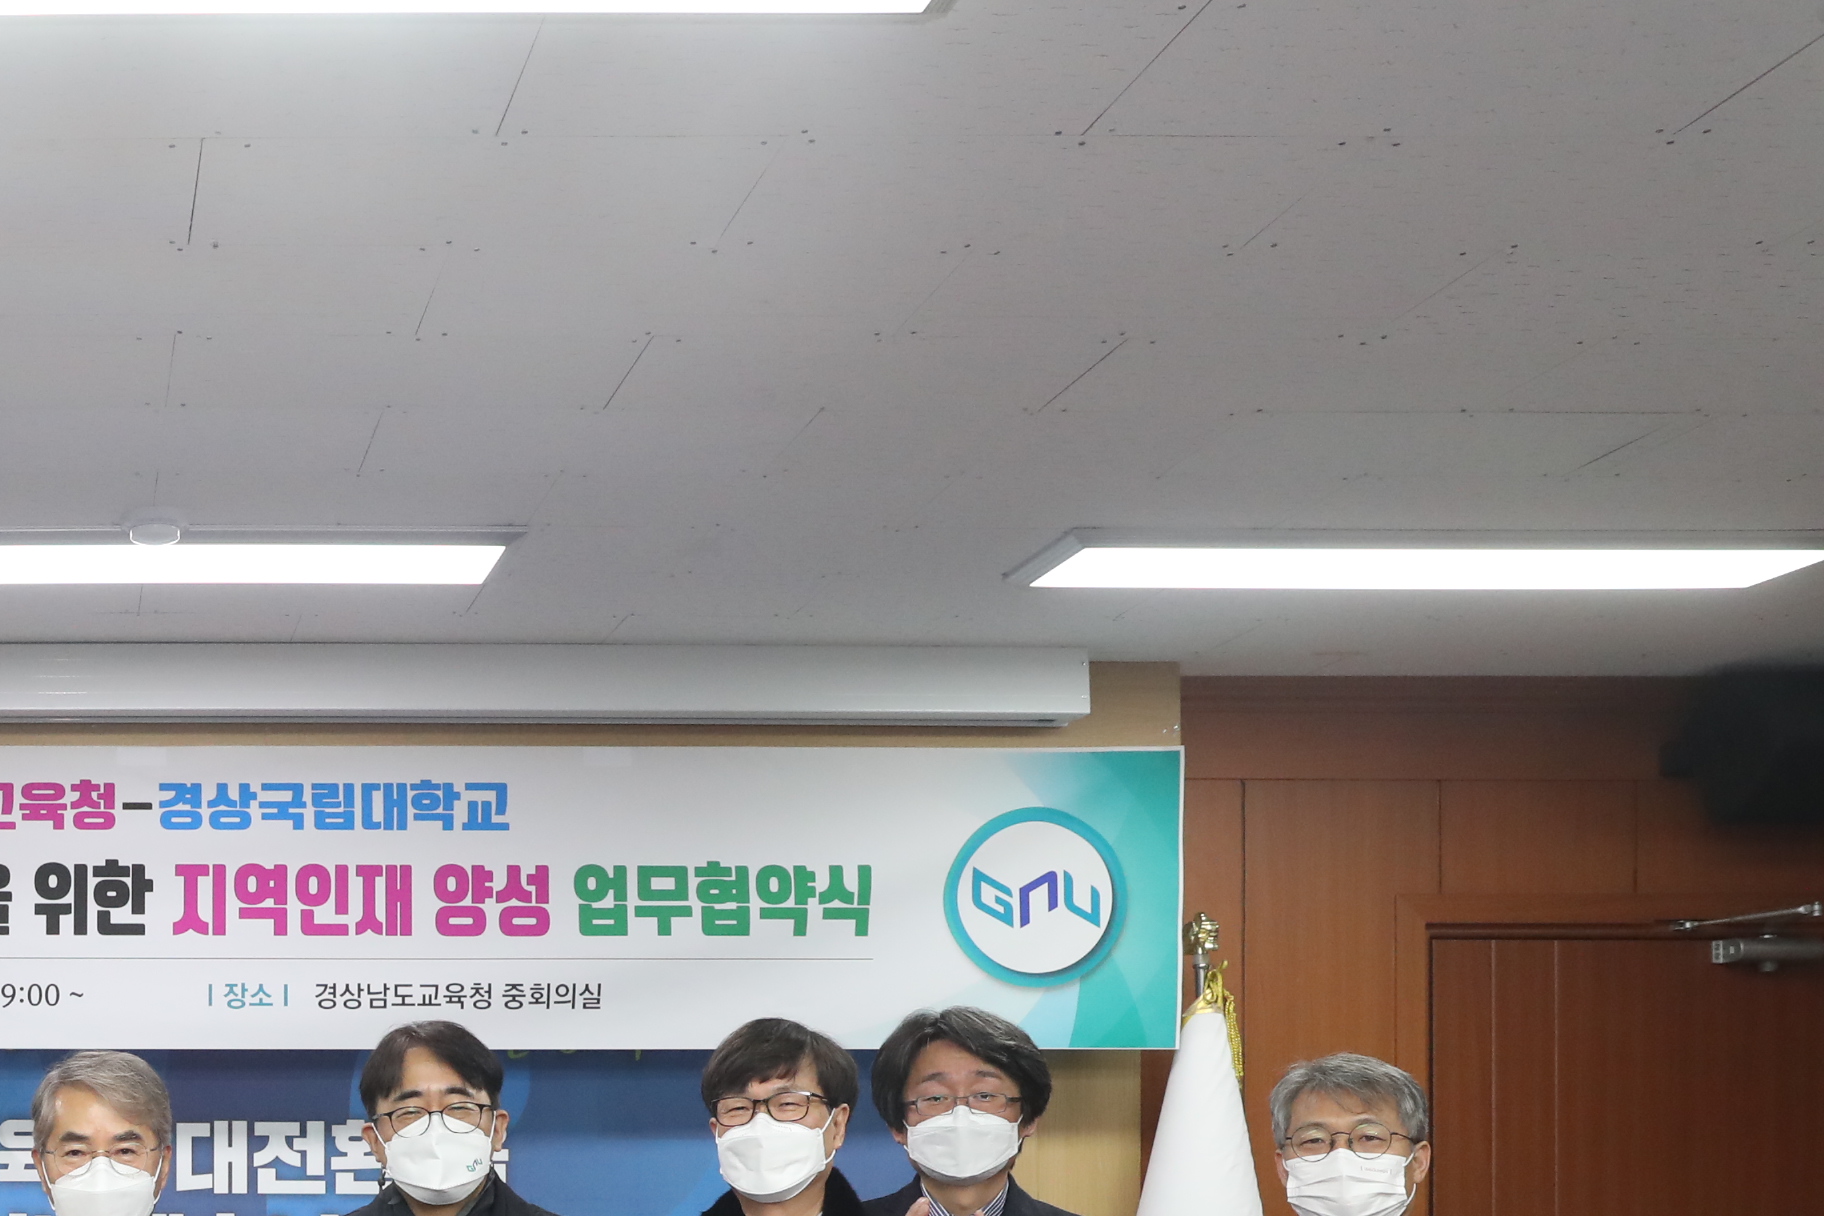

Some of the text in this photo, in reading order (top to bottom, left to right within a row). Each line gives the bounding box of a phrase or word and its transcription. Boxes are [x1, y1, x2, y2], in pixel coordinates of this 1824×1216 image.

[33, 858, 153, 936] 위한
[172, 862, 412, 936] 지역인재
[433, 863, 550, 936] 양성
[573, 860, 872, 936] 업무협약식
[0, 983, 60, 1008] 9:00
[223, 982, 601, 1010] 장소 경상남도교육청 중회의실
